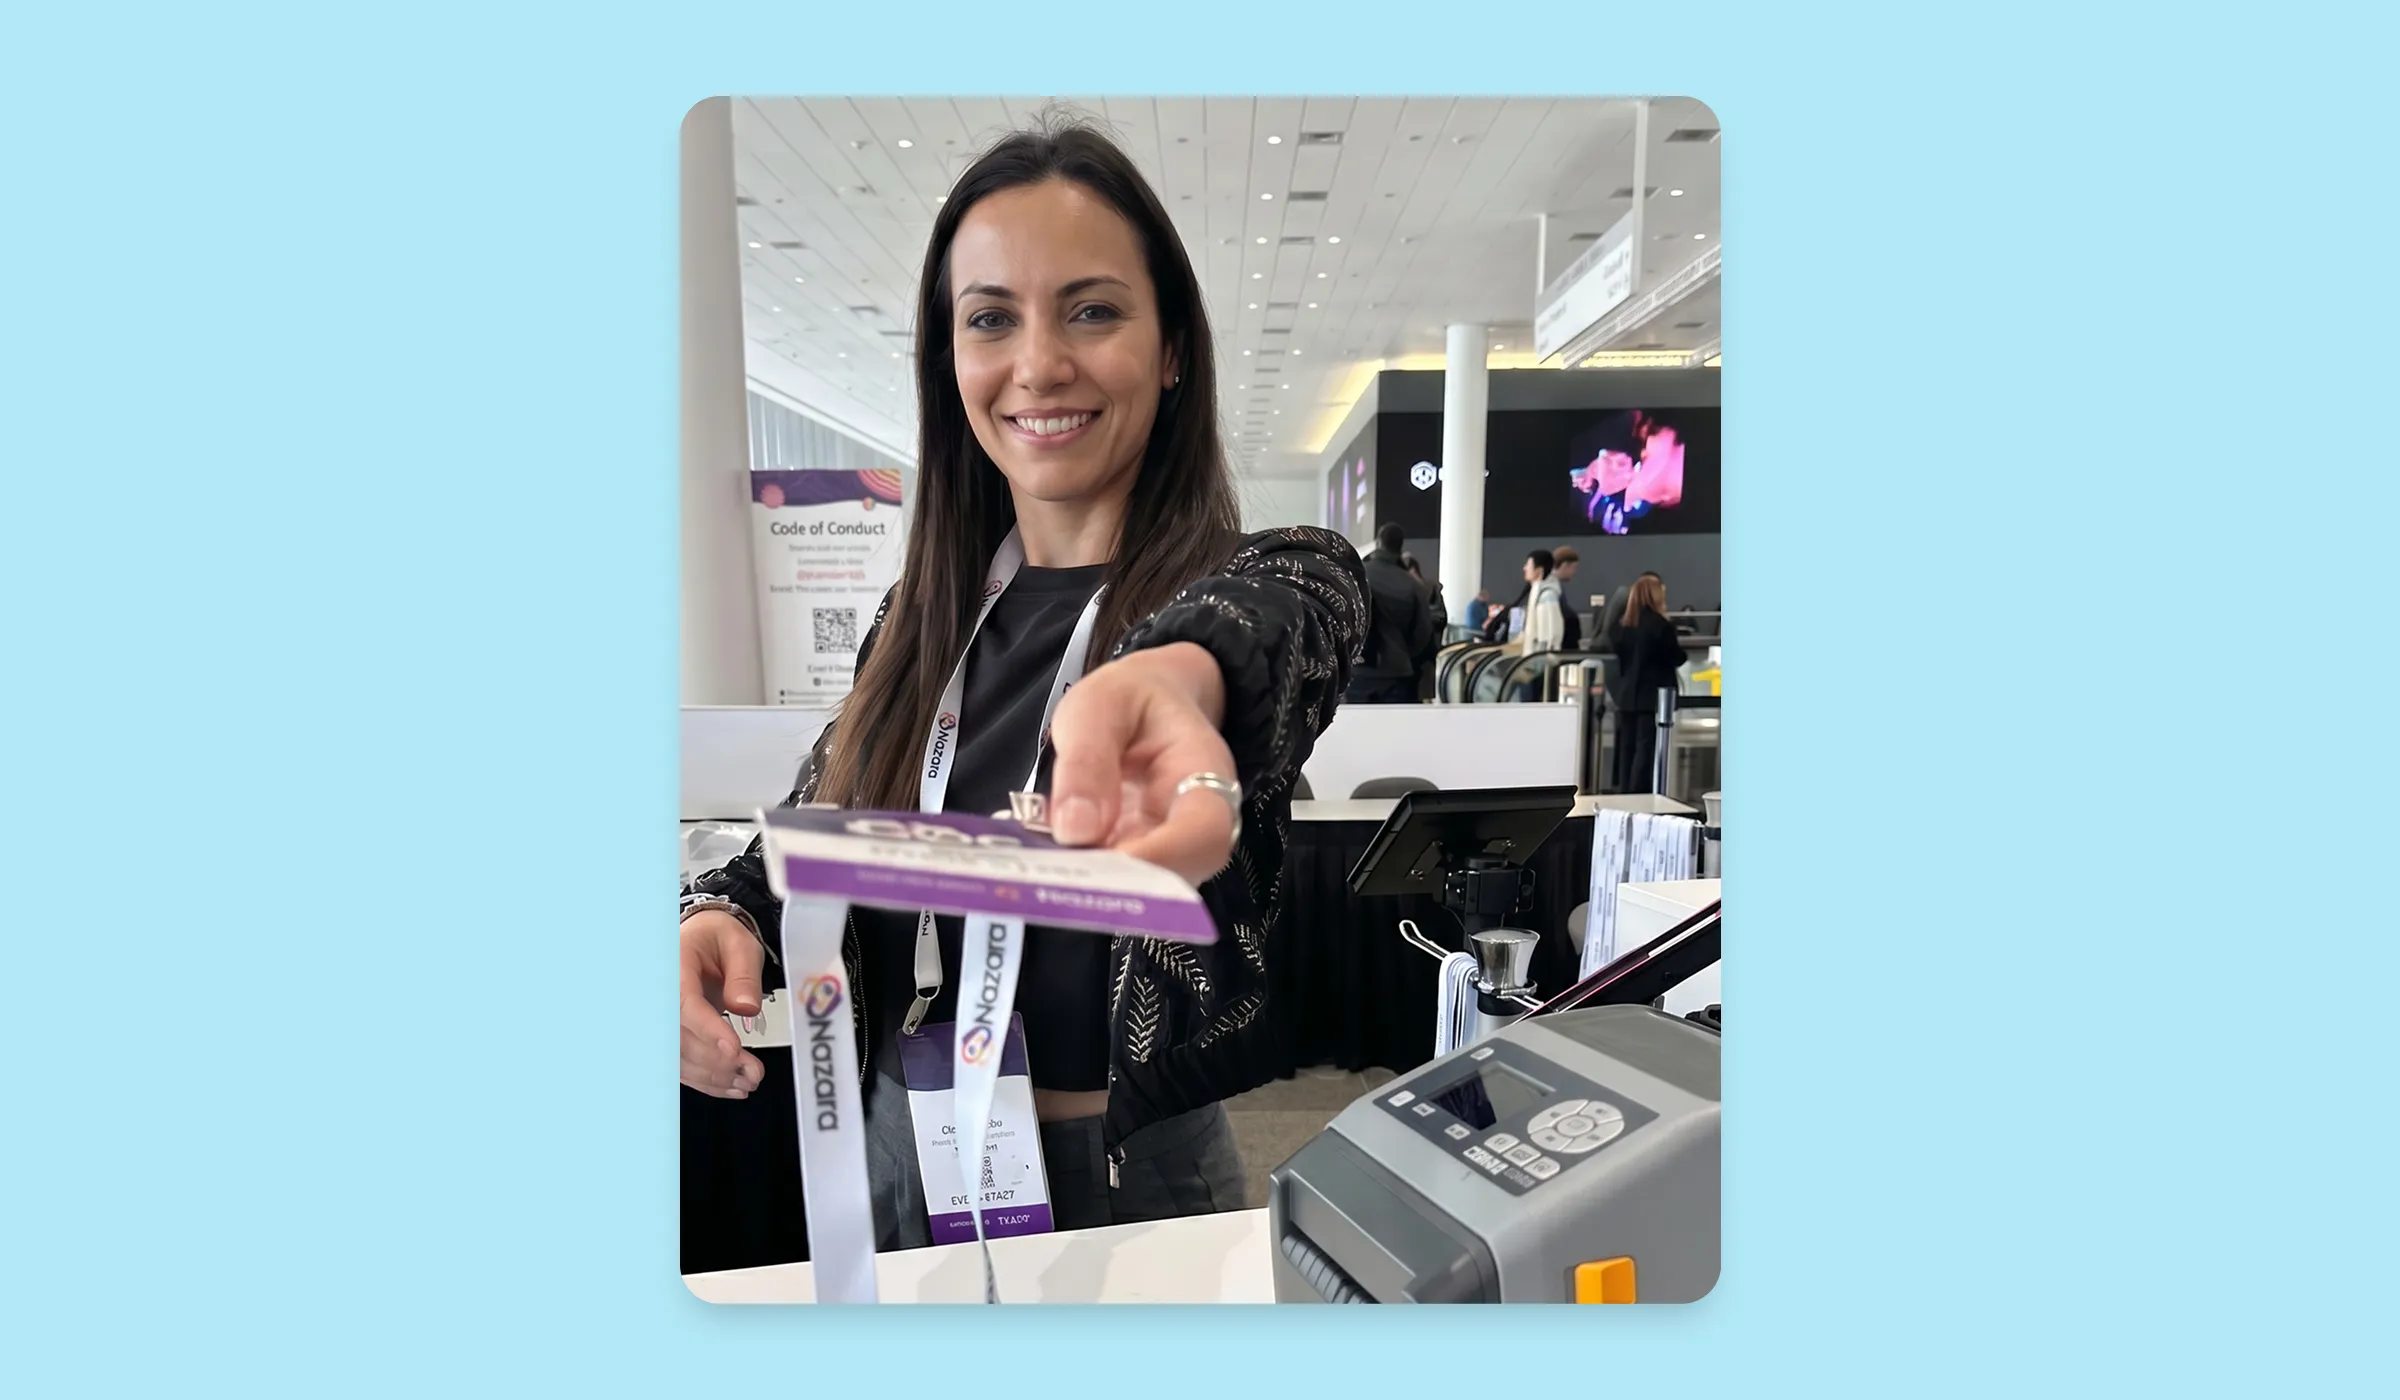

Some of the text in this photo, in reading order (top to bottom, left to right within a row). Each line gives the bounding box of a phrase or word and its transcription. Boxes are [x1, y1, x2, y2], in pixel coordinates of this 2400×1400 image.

[770, 521, 886, 535] Code of Conduct
[928, 730, 949, 779] Nazara
[975, 922, 1007, 1025] Nazara
[808, 1019, 840, 1132] Nazara
